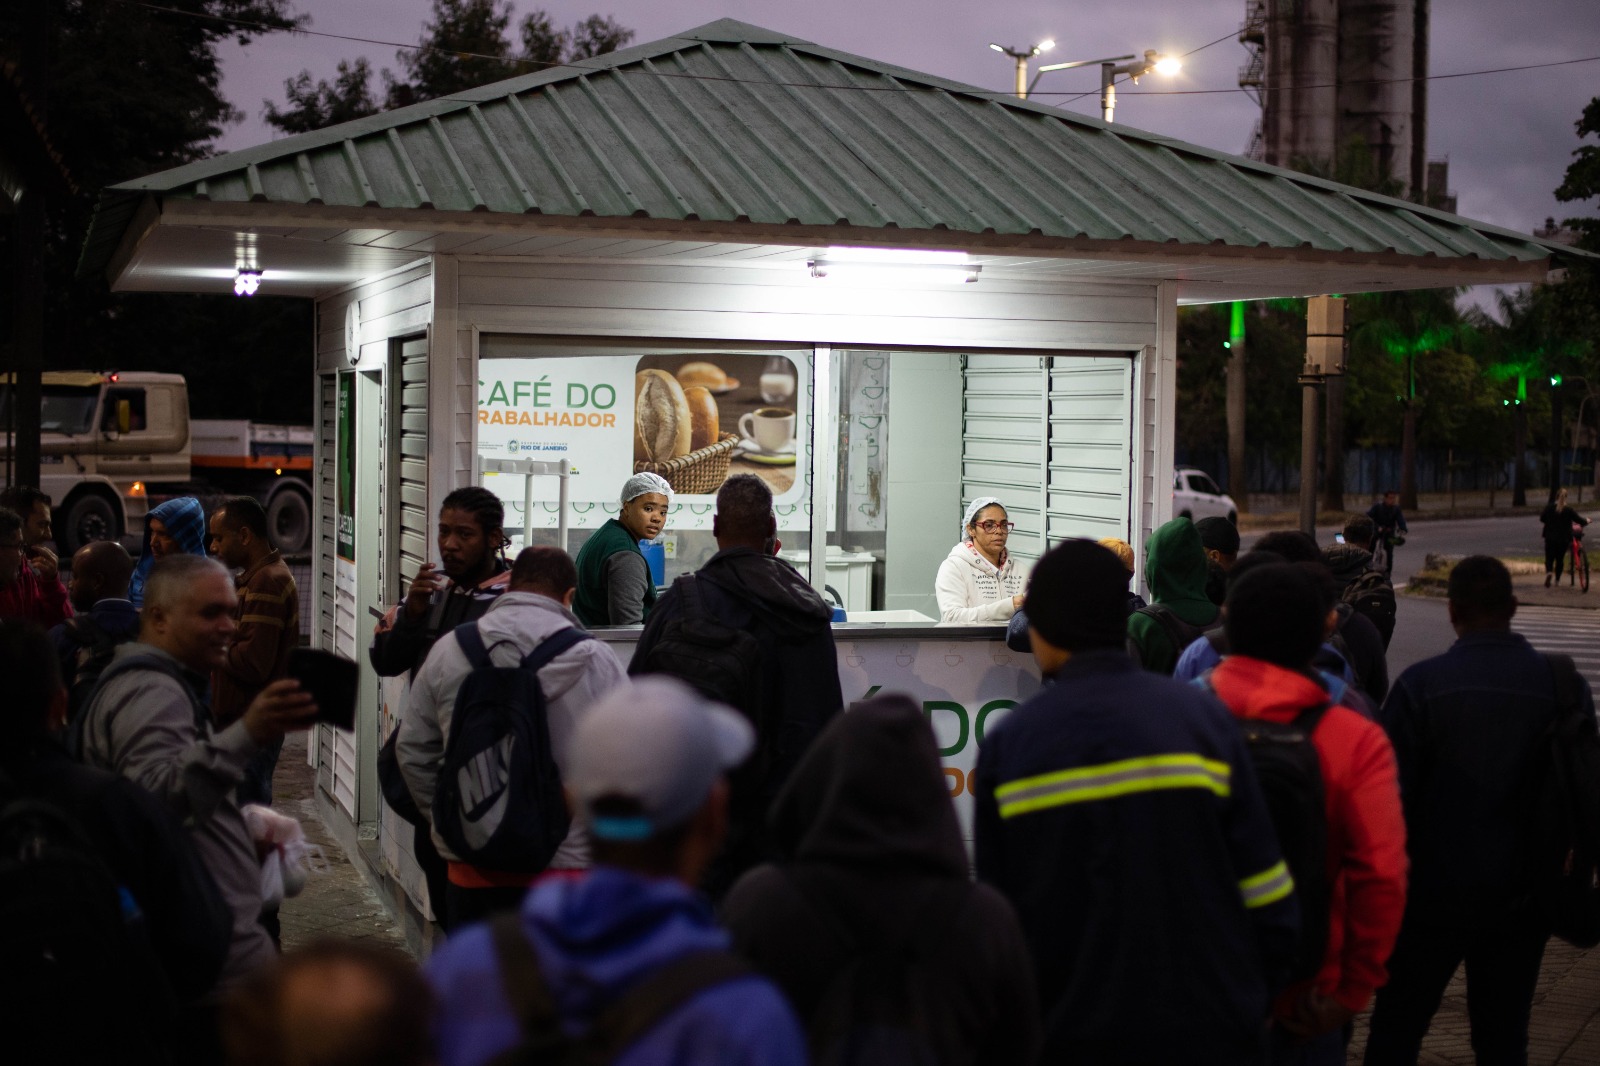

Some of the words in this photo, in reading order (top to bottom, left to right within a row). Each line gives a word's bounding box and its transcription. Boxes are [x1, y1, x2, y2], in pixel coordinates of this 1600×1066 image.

[478, 375, 552, 407] AFÉ
[567, 383, 616, 409] DO
[478, 410, 616, 428] RABALHADOR
[458, 733, 516, 814] NIK
